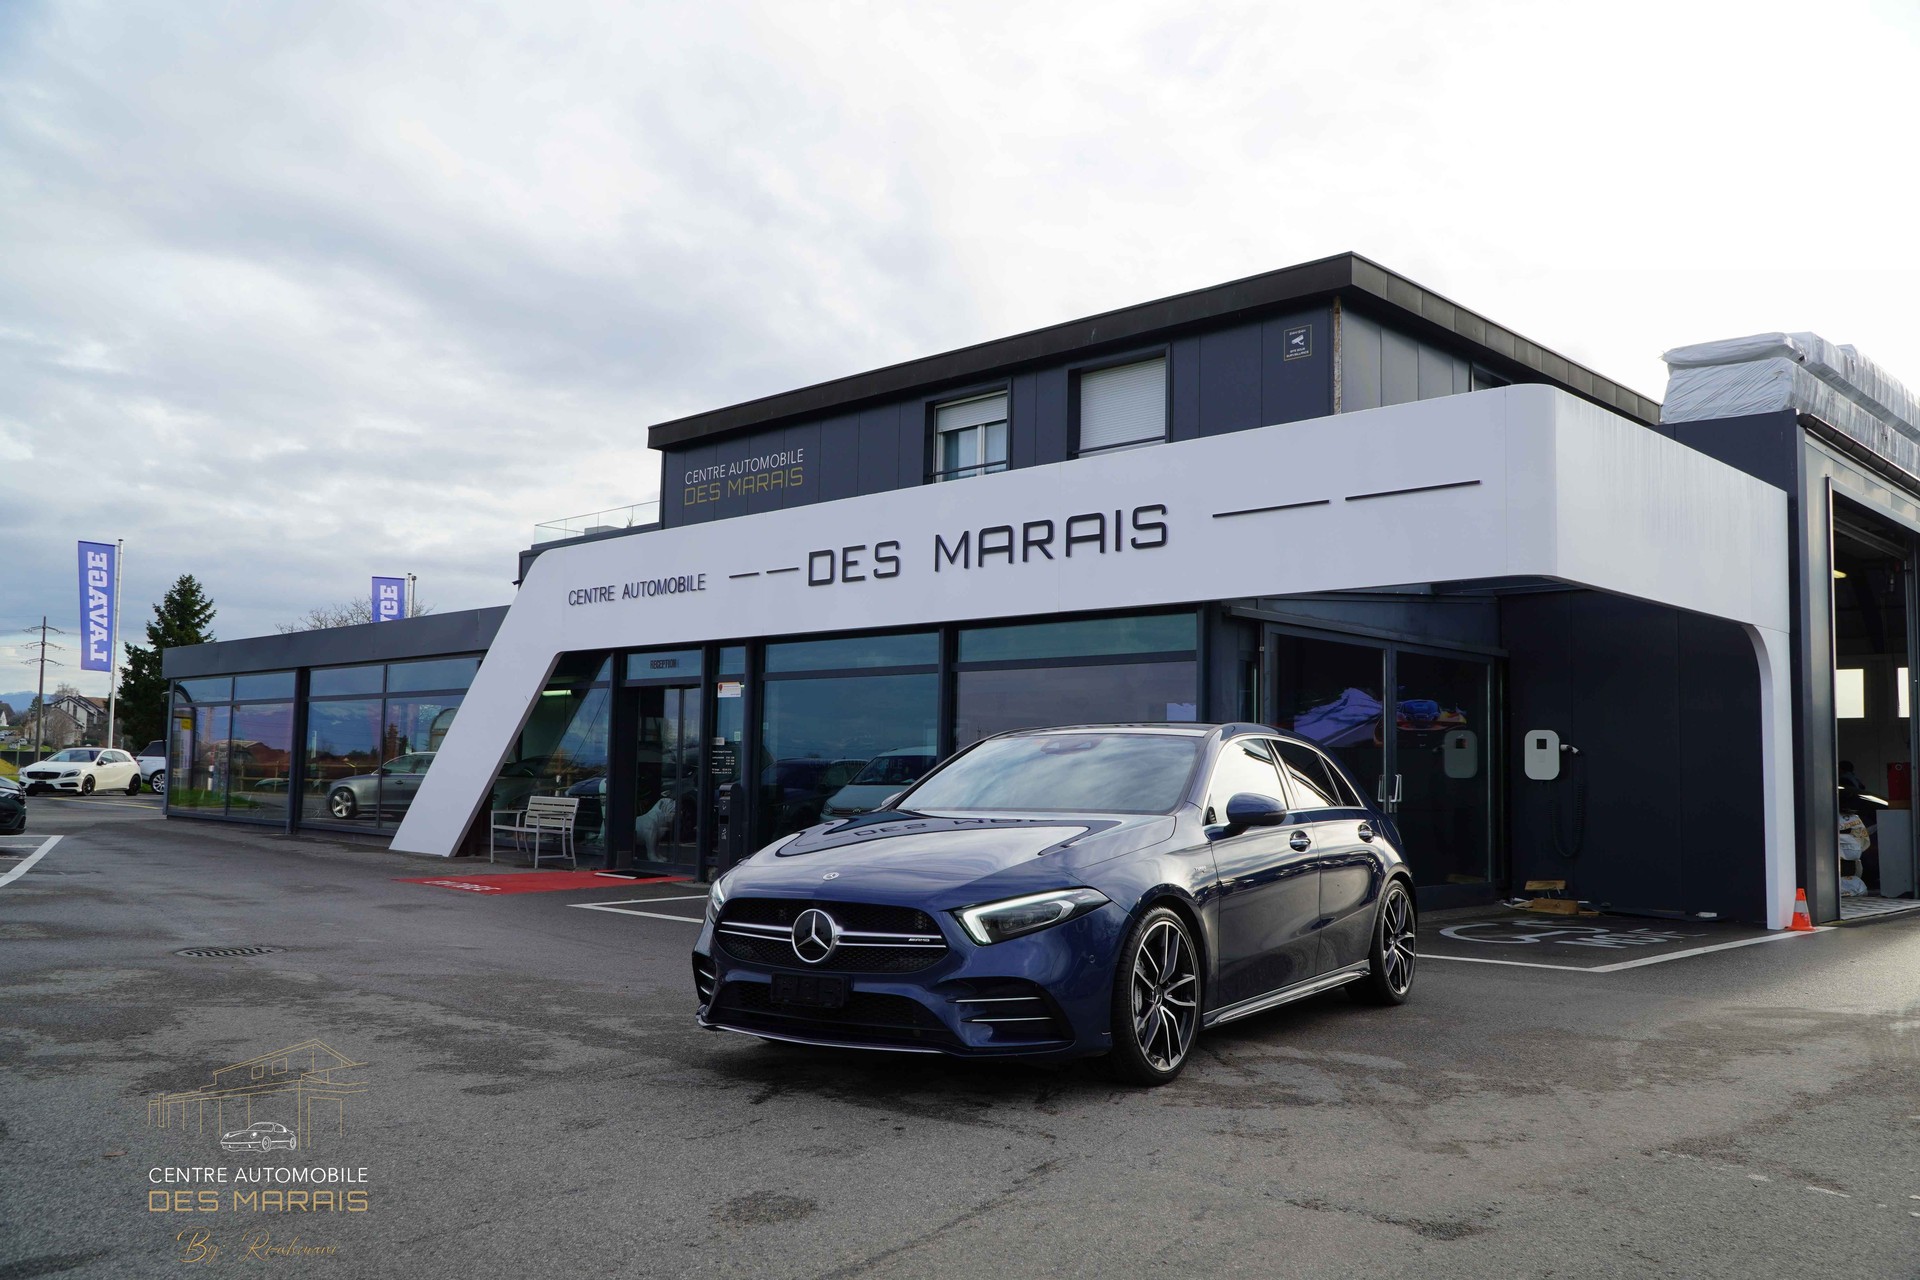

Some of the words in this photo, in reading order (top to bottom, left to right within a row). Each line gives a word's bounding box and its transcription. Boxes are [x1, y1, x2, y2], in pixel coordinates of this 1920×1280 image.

[684, 482, 721, 506] DES
[727, 466, 803, 498] MARAIS
[685, 464, 726, 485] CENTRE
[728, 448, 804, 476] AUTOMOBILE
[568, 585, 616, 606] CENTRE
[622, 573, 707, 600] AUTOMOBILE
[808, 540, 902, 587] DES
[934, 503, 1169, 573] MARAIS
